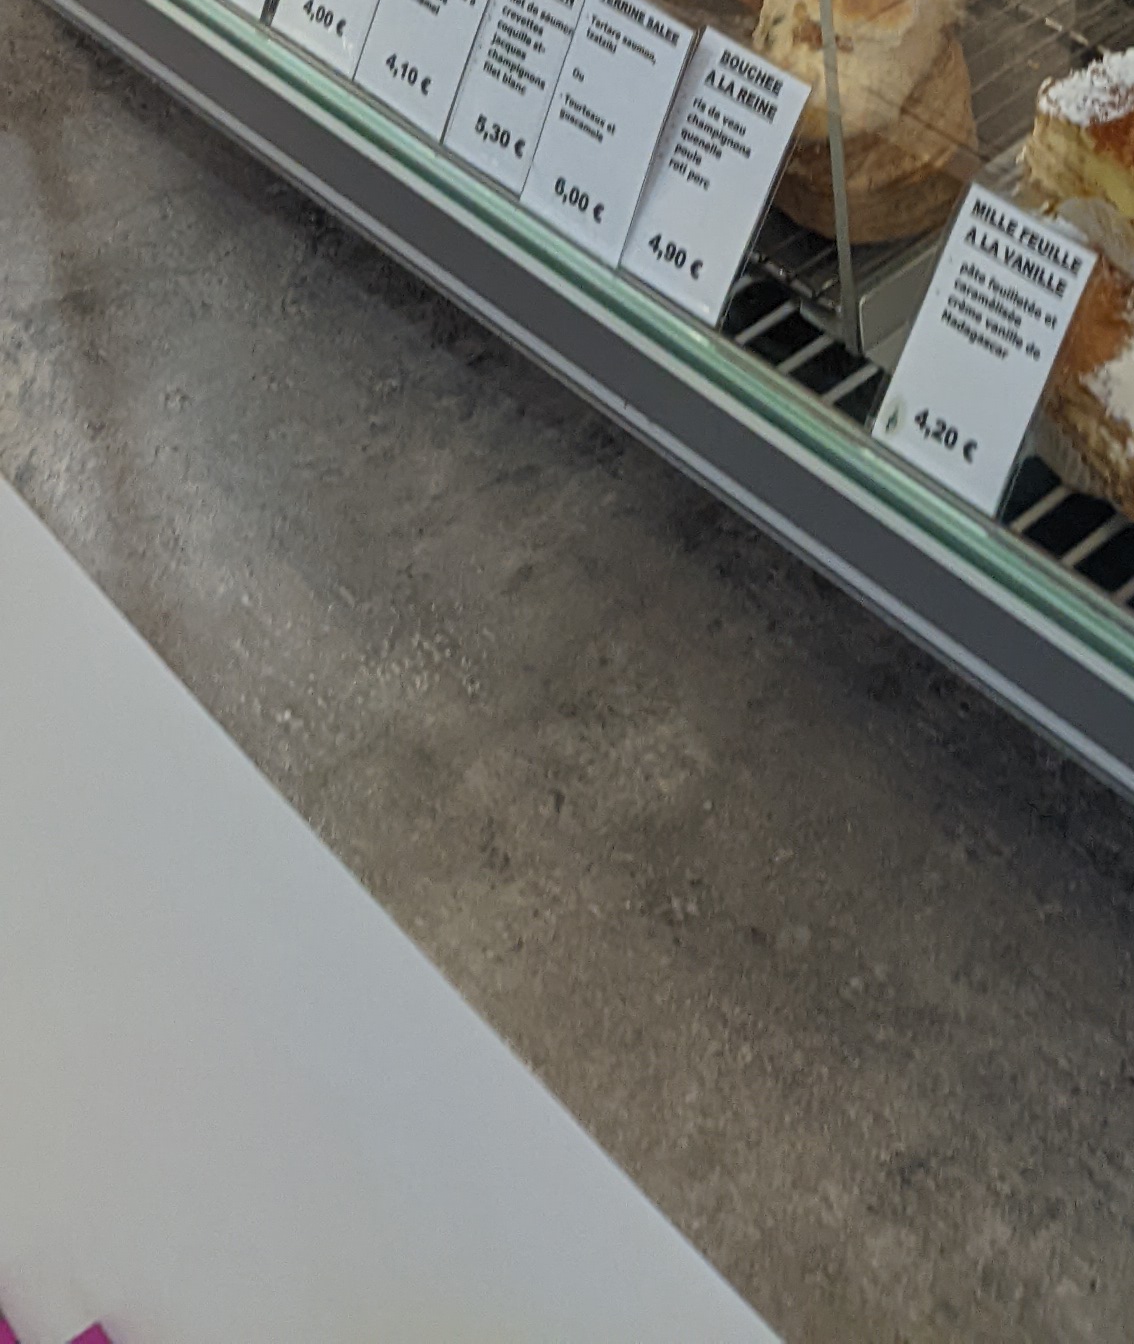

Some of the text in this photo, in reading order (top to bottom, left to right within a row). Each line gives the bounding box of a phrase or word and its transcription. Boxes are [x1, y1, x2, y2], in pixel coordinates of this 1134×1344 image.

[334, 16, 347, 37] €
[501, 3, 544, 38] crevettes
[526, 0, 540, 16] de
[496, 17, 532, 48] coquille
[585, 26, 617, 54] tzatziki
[645, 16, 680, 46] SALEE
[382, 50, 433, 96] 4,10 €
[482, 59, 527, 96] filet blanc
[486, 44, 547, 93] champignons
[571, 67, 585, 83] Ou
[719, 47, 783, 97] BOUCHEE
[563, 92, 616, 135] Tourteaux et
[691, 95, 747, 138] ris de veau
[705, 67, 778, 122] A LA REINE
[473, 111, 526, 159] 5,30 €
[558, 105, 604, 144] guacamole
[679, 125, 723, 161] quenelle
[684, 109, 752, 161] champignons
[673, 140, 703, 168] poule
[551, 174, 605, 224] 6,00 €
[685, 168, 711, 193] porc
[644, 229, 704, 281] 4,90 €
[970, 198, 1084, 276] MILLE FEUILLE
[964, 224, 1068, 298] A LA VANILLE
[957, 258, 988, 288] pâte
[1042, 309, 1060, 330] et
[938, 308, 1010, 364] Madagascar
[945, 292, 1043, 361] crème vanille de
[910, 404, 980, 466] 4,20 €
